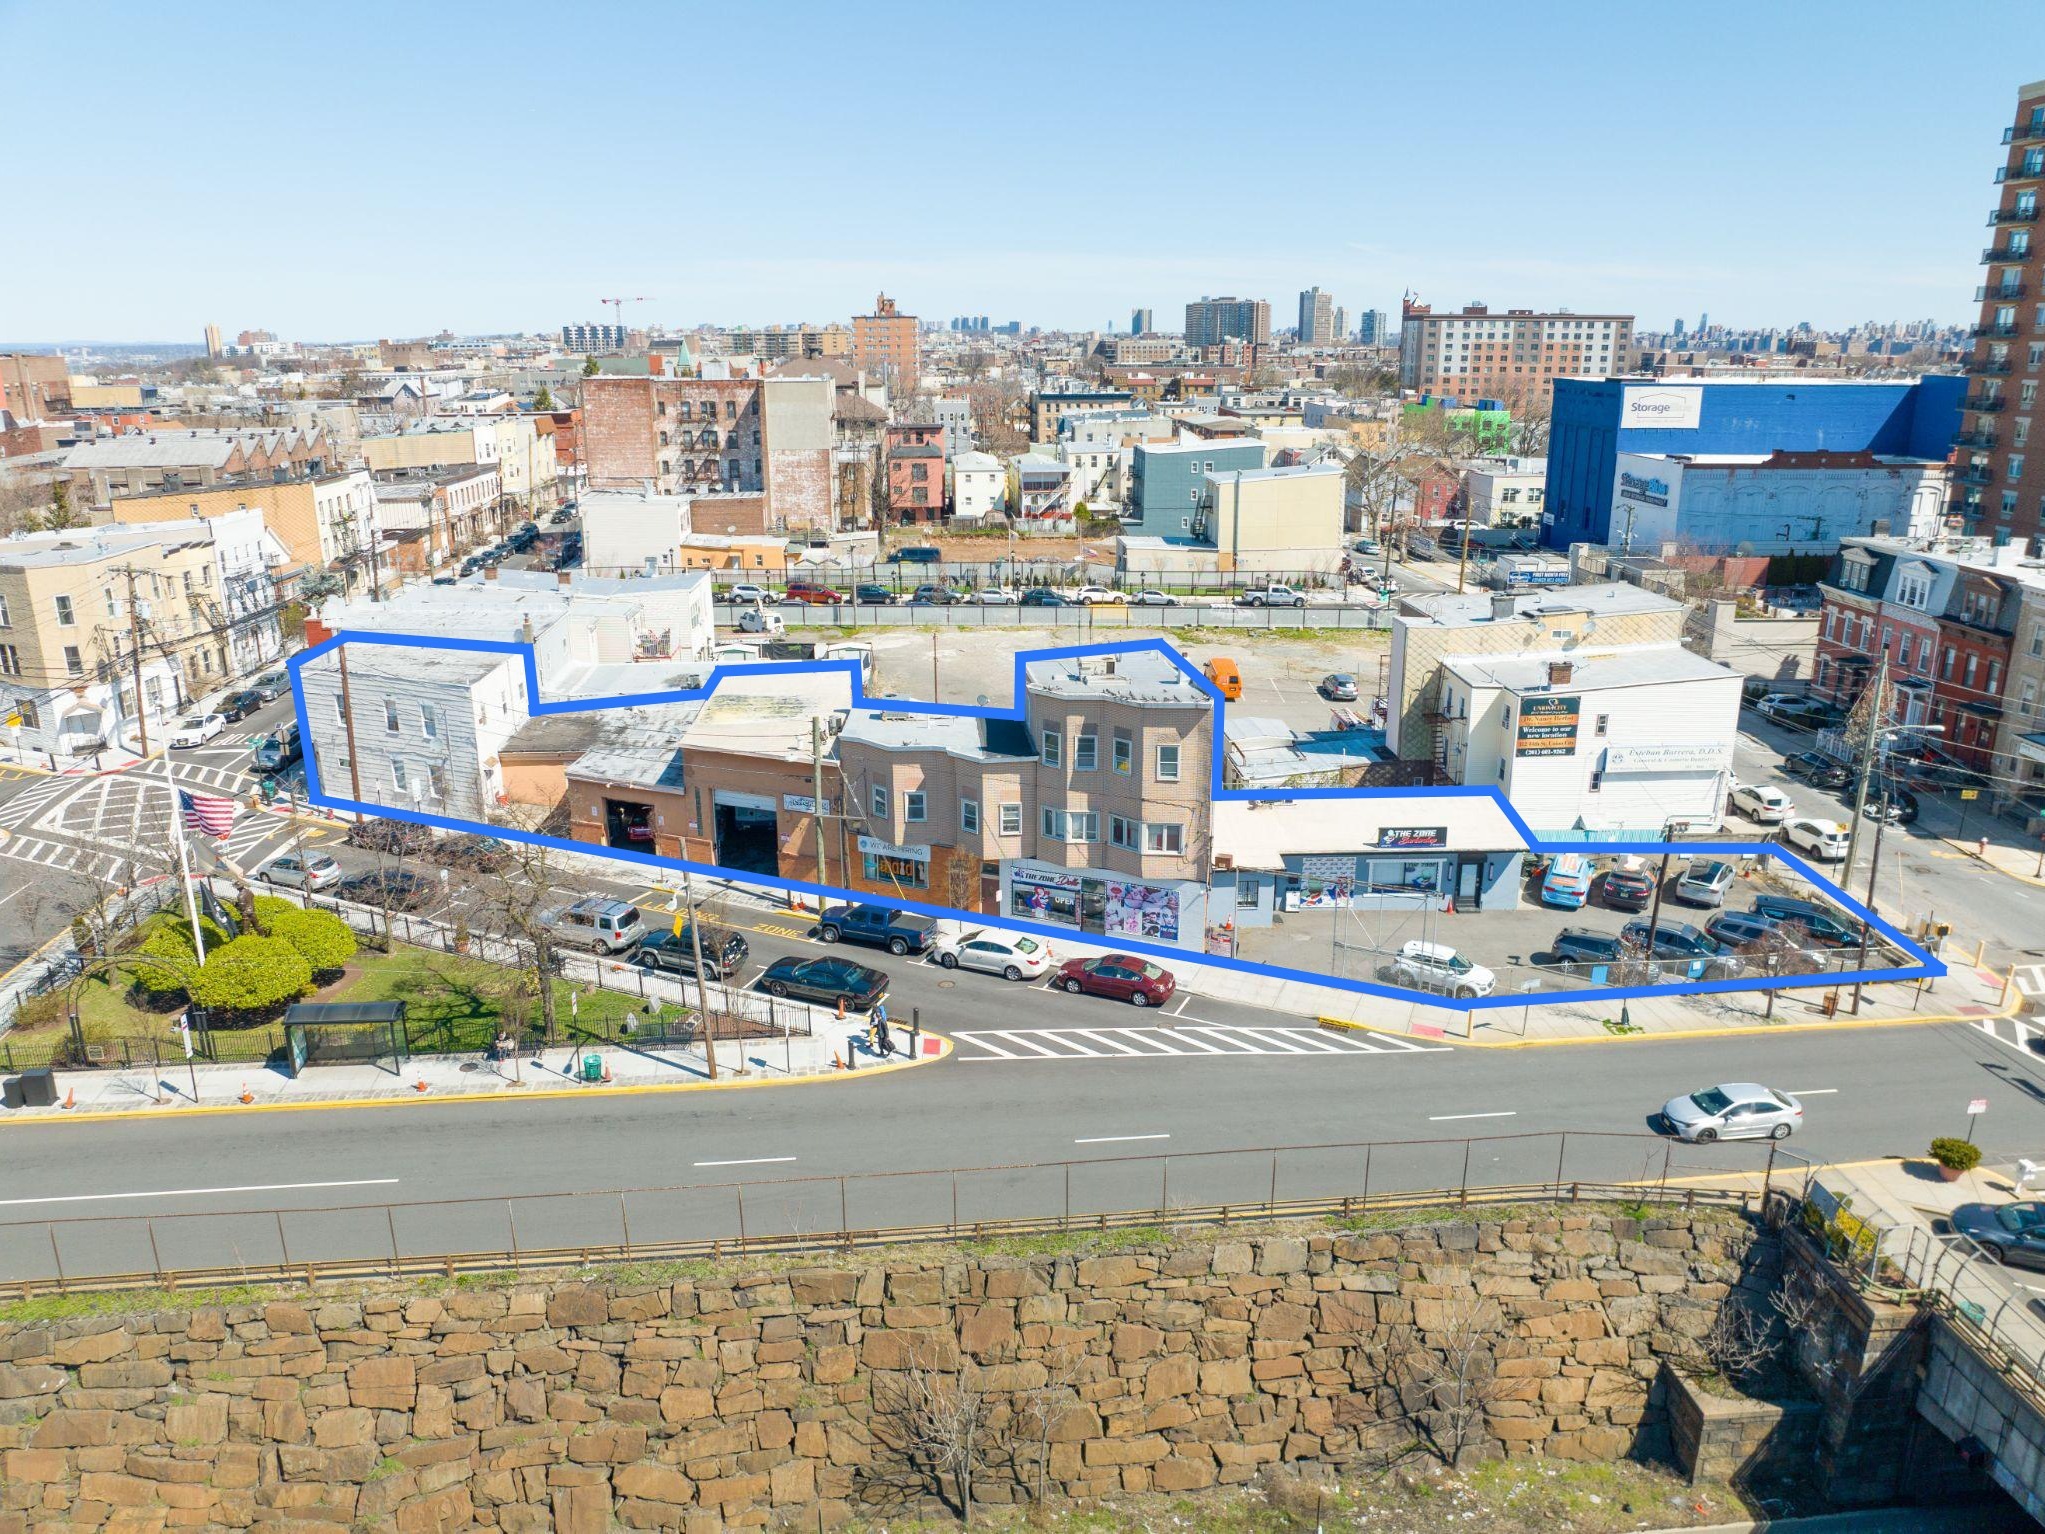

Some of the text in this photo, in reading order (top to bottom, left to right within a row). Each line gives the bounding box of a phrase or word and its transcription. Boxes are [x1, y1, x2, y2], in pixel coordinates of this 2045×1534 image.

[1631, 402, 1671, 414] Storage
[1394, 829, 1437, 838] THE ZONE
[883, 843, 896, 852] ARE
[1025, 872, 1037, 881] THE
[1038, 874, 1056, 883] ZONE
[1054, 896, 1075, 905] OPEN
[753, 923, 804, 938] ZONE
